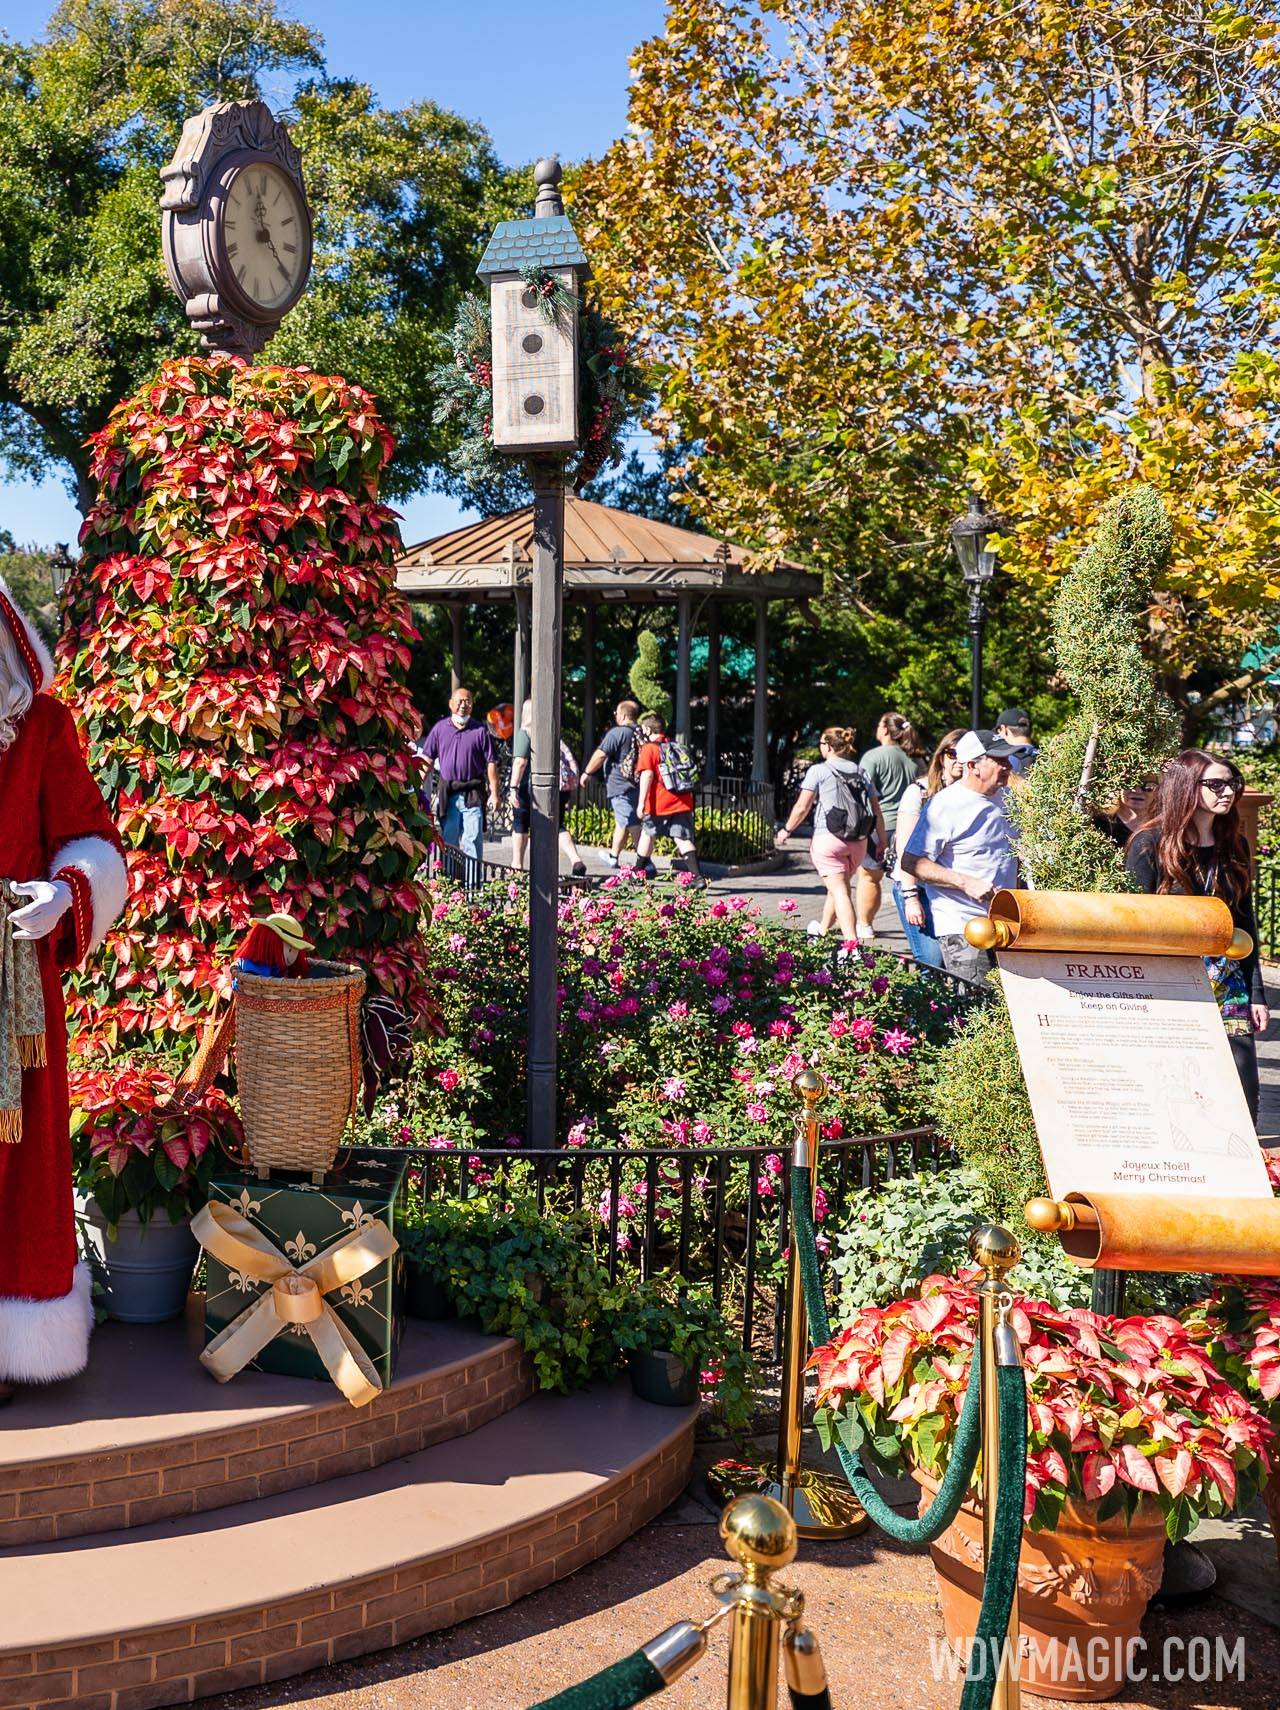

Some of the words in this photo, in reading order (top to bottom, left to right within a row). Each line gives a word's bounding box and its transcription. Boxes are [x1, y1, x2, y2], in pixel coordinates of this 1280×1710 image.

[1065, 964, 1145, 979] FRANCE
[1069, 990, 1094, 1000] Enjoy
[1096, 991, 1111, 999] the
[1112, 991, 1134, 999] Gifts
[1135, 992, 1154, 1000] that
[1080, 1001, 1104, 1011] Keep
[1119, 1002, 1149, 1013] Giving
[1122, 1160, 1160, 1171] Joyeux
[1113, 1171, 1145, 1183] Merry
[1148, 1173, 1206, 1184] Christmas!
